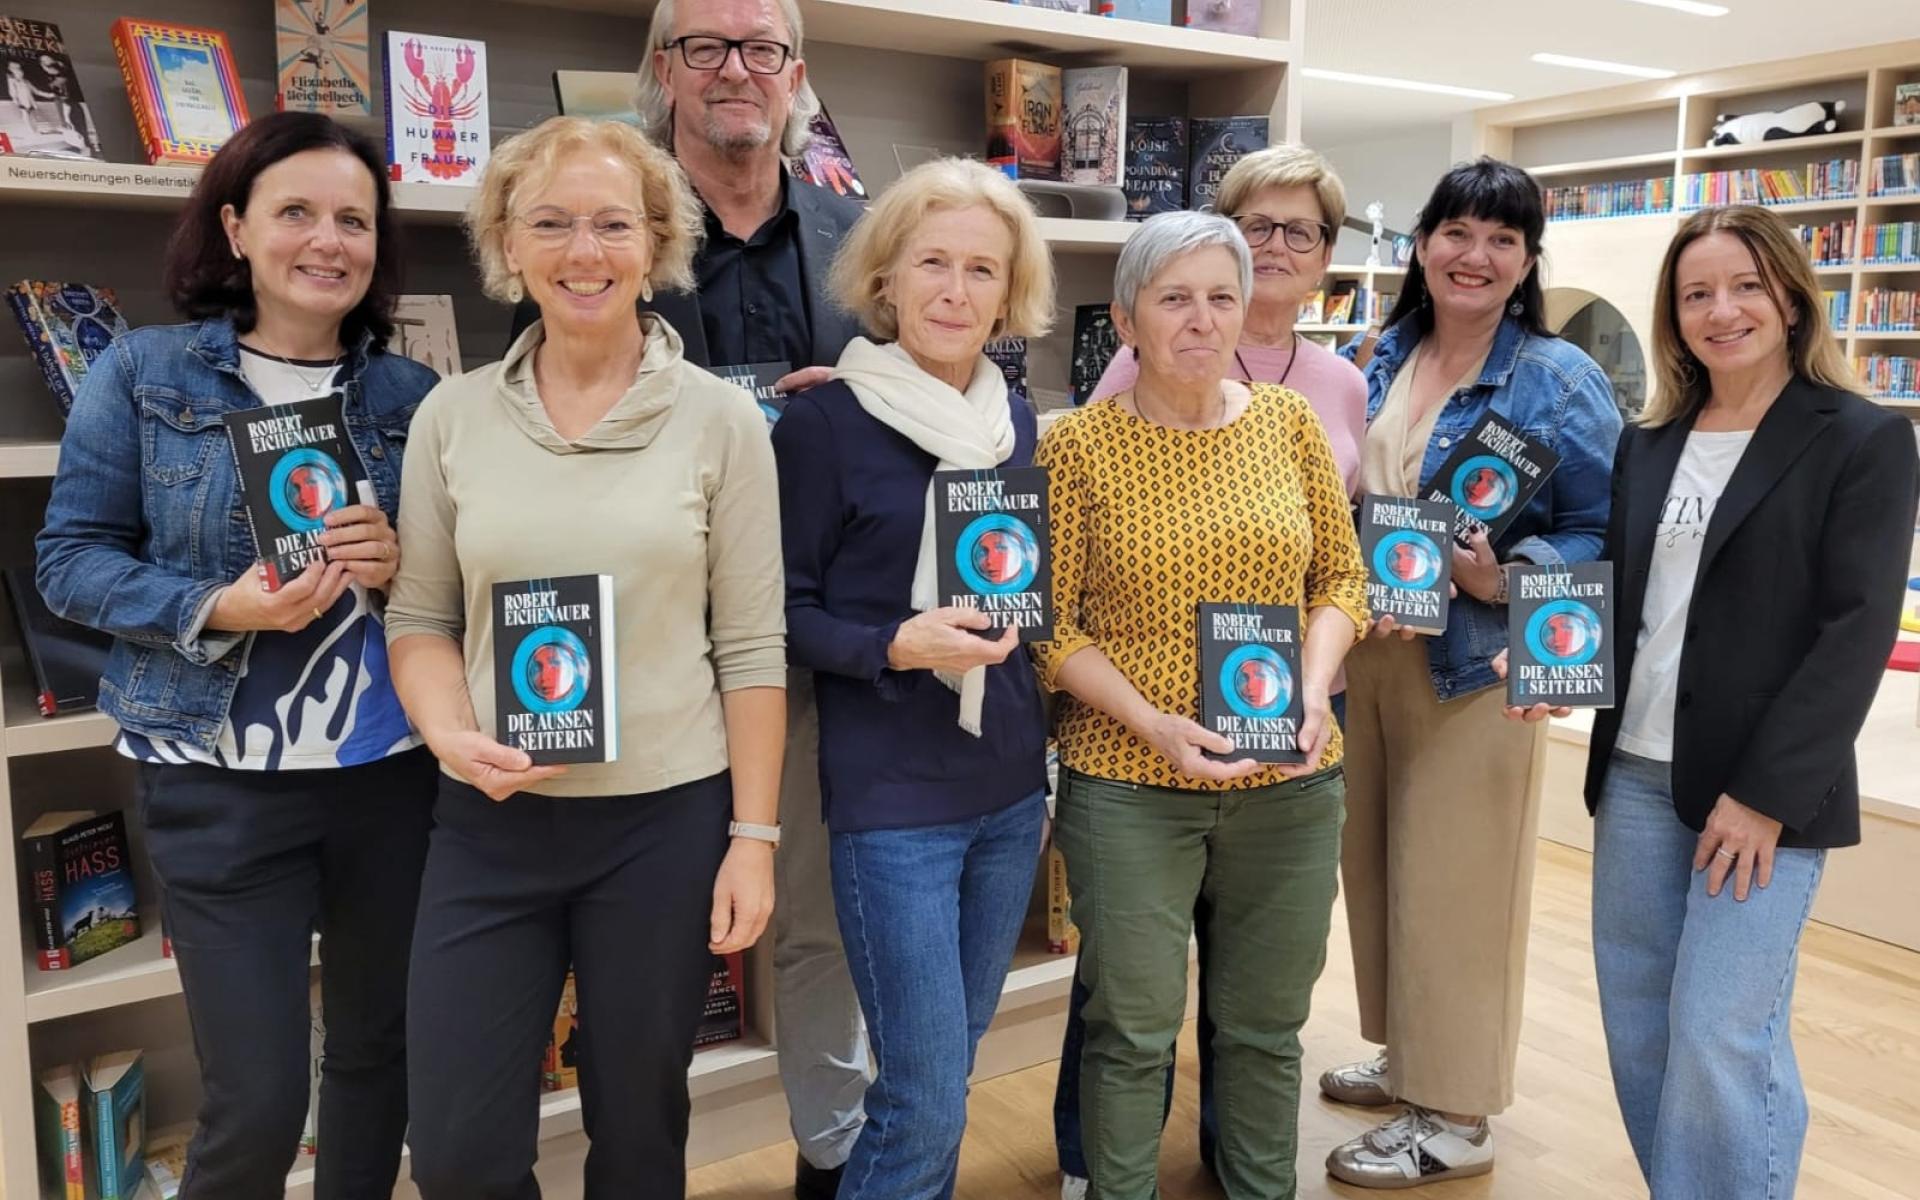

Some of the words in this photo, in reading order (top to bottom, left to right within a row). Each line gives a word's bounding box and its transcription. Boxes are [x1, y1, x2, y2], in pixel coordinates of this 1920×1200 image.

[429, 104, 455, 116] DIE
[406, 127, 479, 143] HUMMER
[411, 152, 476, 166] FRAUEN
[8, 167, 131, 186] Neuerscheinungen
[135, 174, 197, 188] Belletristik
[1125, 179, 1172, 192] HEARTS
[247, 414, 303, 439] ROBERT
[251, 424, 337, 454] EICHENAUER
[1484, 420, 1528, 454] ROBERT
[1476, 430, 1542, 479] EICHENAUER
[947, 480, 1005, 497] ROBERT
[948, 494, 1039, 512] EICHENAUER
[1373, 502, 1421, 519] ROBERT
[1372, 513, 1447, 533] EICHENAUER
[275, 534, 303, 555] DIE
[1520, 573, 1574, 587] ROBERT
[504, 590, 558, 611] ROBERT
[1366, 583, 1388, 598] DIE
[1390, 587, 1441, 604] AUSSEN
[1520, 583, 1604, 599] EICHENAUER
[951, 594, 980, 609] DIE
[982, 592, 1042, 611] AUSSEN
[1372, 599, 1440, 618] SEITERIN
[505, 604, 591, 626] EICHENAUER
[1212, 612, 1263, 628] ROBERT
[1213, 626, 1292, 643] EICHENAUER
[1519, 665, 1546, 680] DIE
[1548, 663, 1603, 680] AUSSEN
[1529, 678, 1603, 695] SEITERIN
[507, 713, 534, 732] DIE
[537, 709, 594, 731] AUSSEN
[1216, 715, 1242, 732] DIE
[1243, 716, 1296, 733] AUSSEN
[518, 729, 594, 751] SEITERIN
[1228, 732, 1297, 750] SEITERIN
[64, 846, 120, 884] HASS
[40, 870, 56, 901] HASS
